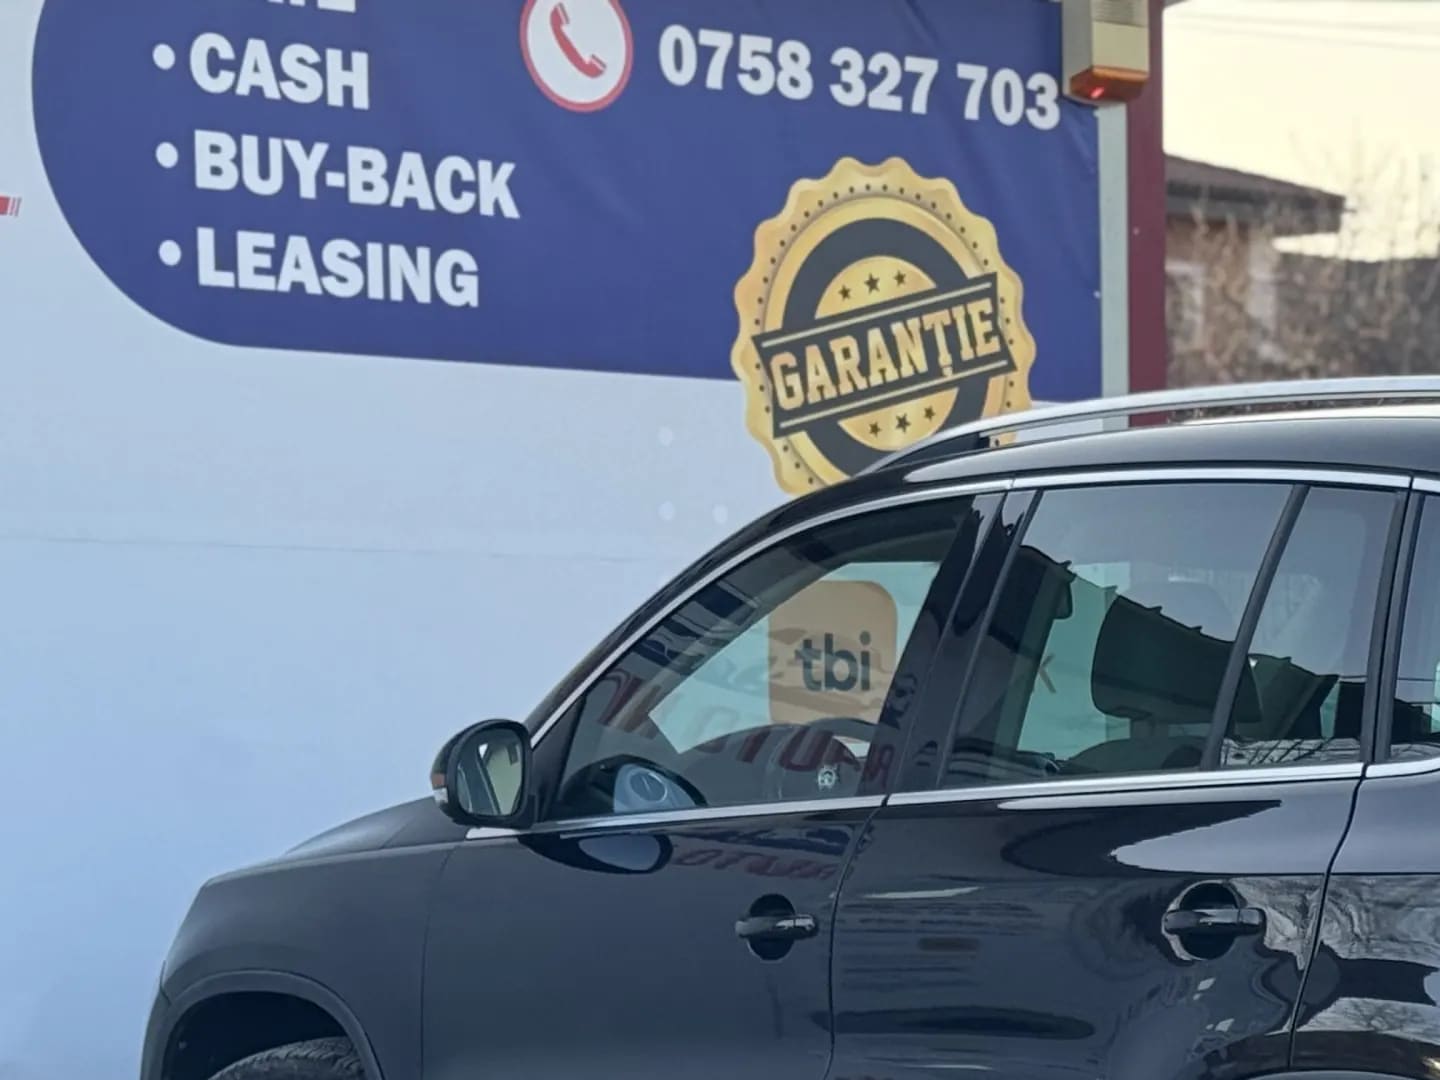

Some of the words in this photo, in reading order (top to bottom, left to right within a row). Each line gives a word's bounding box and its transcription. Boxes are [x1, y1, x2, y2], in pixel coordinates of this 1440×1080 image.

[189, 32, 370, 111] CASH
[659, 25, 813, 100] 0758
[829, 47, 939, 115] 327
[956, 63, 1060, 131] 703
[194, 129, 521, 219] BUY-BACK
[197, 227, 480, 308] LEASING
[797, 631, 871, 692] tbi
